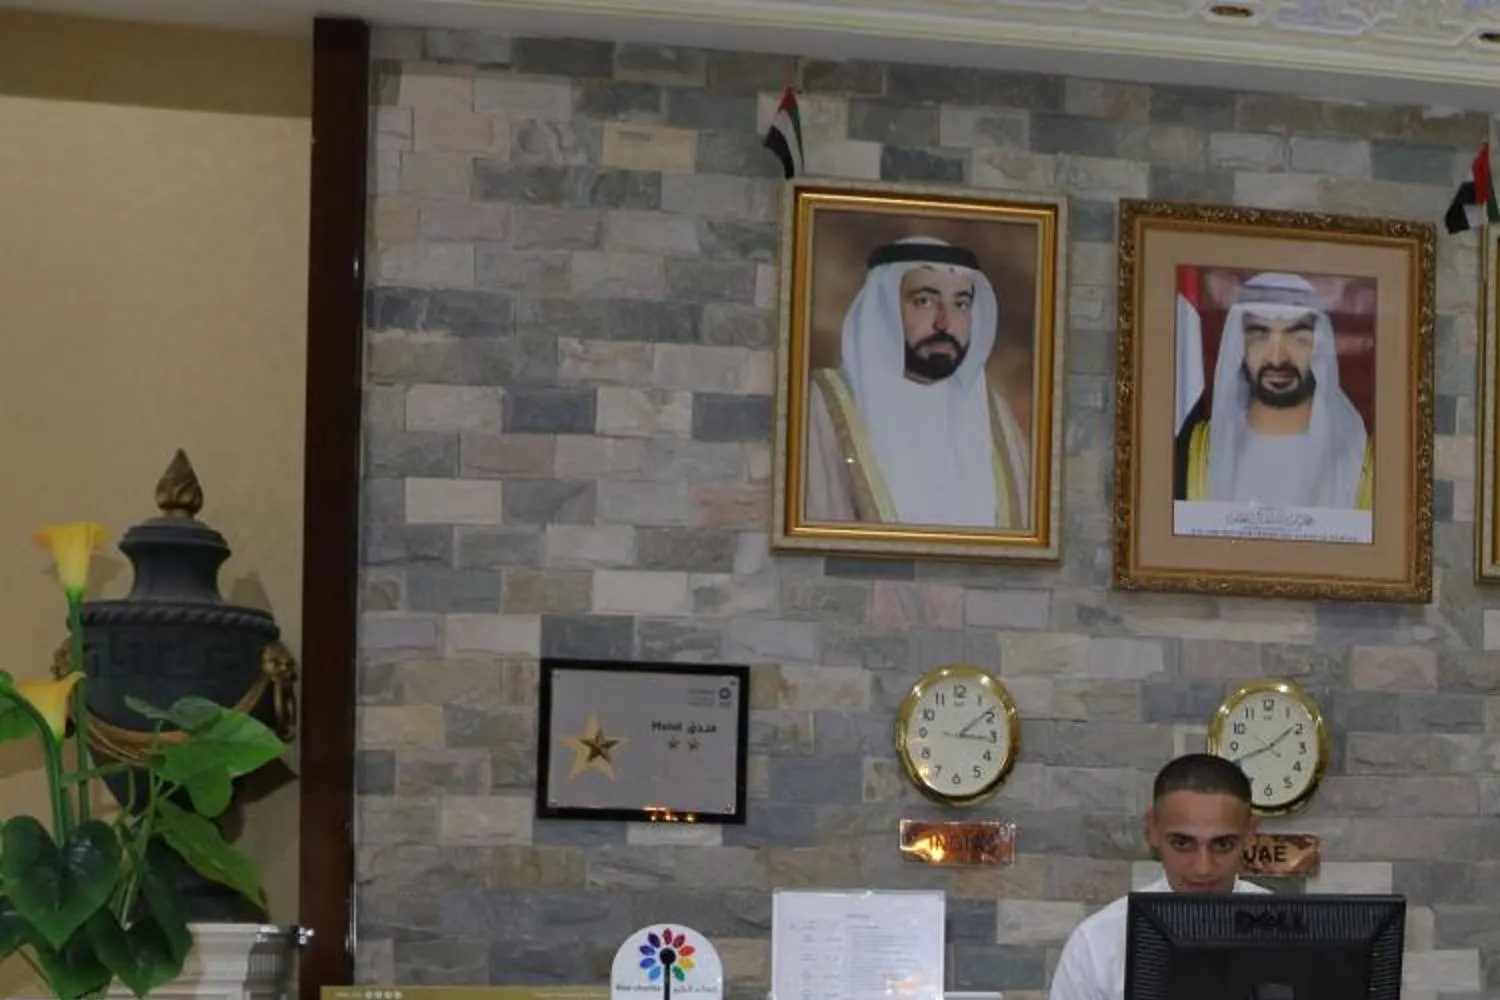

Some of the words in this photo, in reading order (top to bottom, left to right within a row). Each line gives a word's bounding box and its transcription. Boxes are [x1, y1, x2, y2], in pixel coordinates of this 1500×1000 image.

[954, 684, 967, 698] 12
[935, 692, 945, 705] 11
[1263, 699, 1274, 711] 12
[923, 708, 935, 721] 10
[985, 709, 995, 724] 2
[1245, 707, 1254, 720] 11
[919, 727, 928, 738] 9
[1233, 723, 1246, 735] 10
[1295, 723, 1303, 735] 2
[990, 730, 997, 743] 3
[1230, 740, 1239, 752] 9
[1298, 741, 1307, 755] 3
[921, 747, 931, 759] 8
[983, 750, 991, 761] 4
[934, 764, 942, 777] 7
[973, 765, 981, 778] 5
[1293, 761, 1302, 772] 4
[952, 773, 961, 785] 6
[1283, 776, 1293, 789] 5
[1263, 783, 1273, 797] 6
[1242, 844, 1288, 863] UAE
[1234, 909, 1309, 934] DELL
